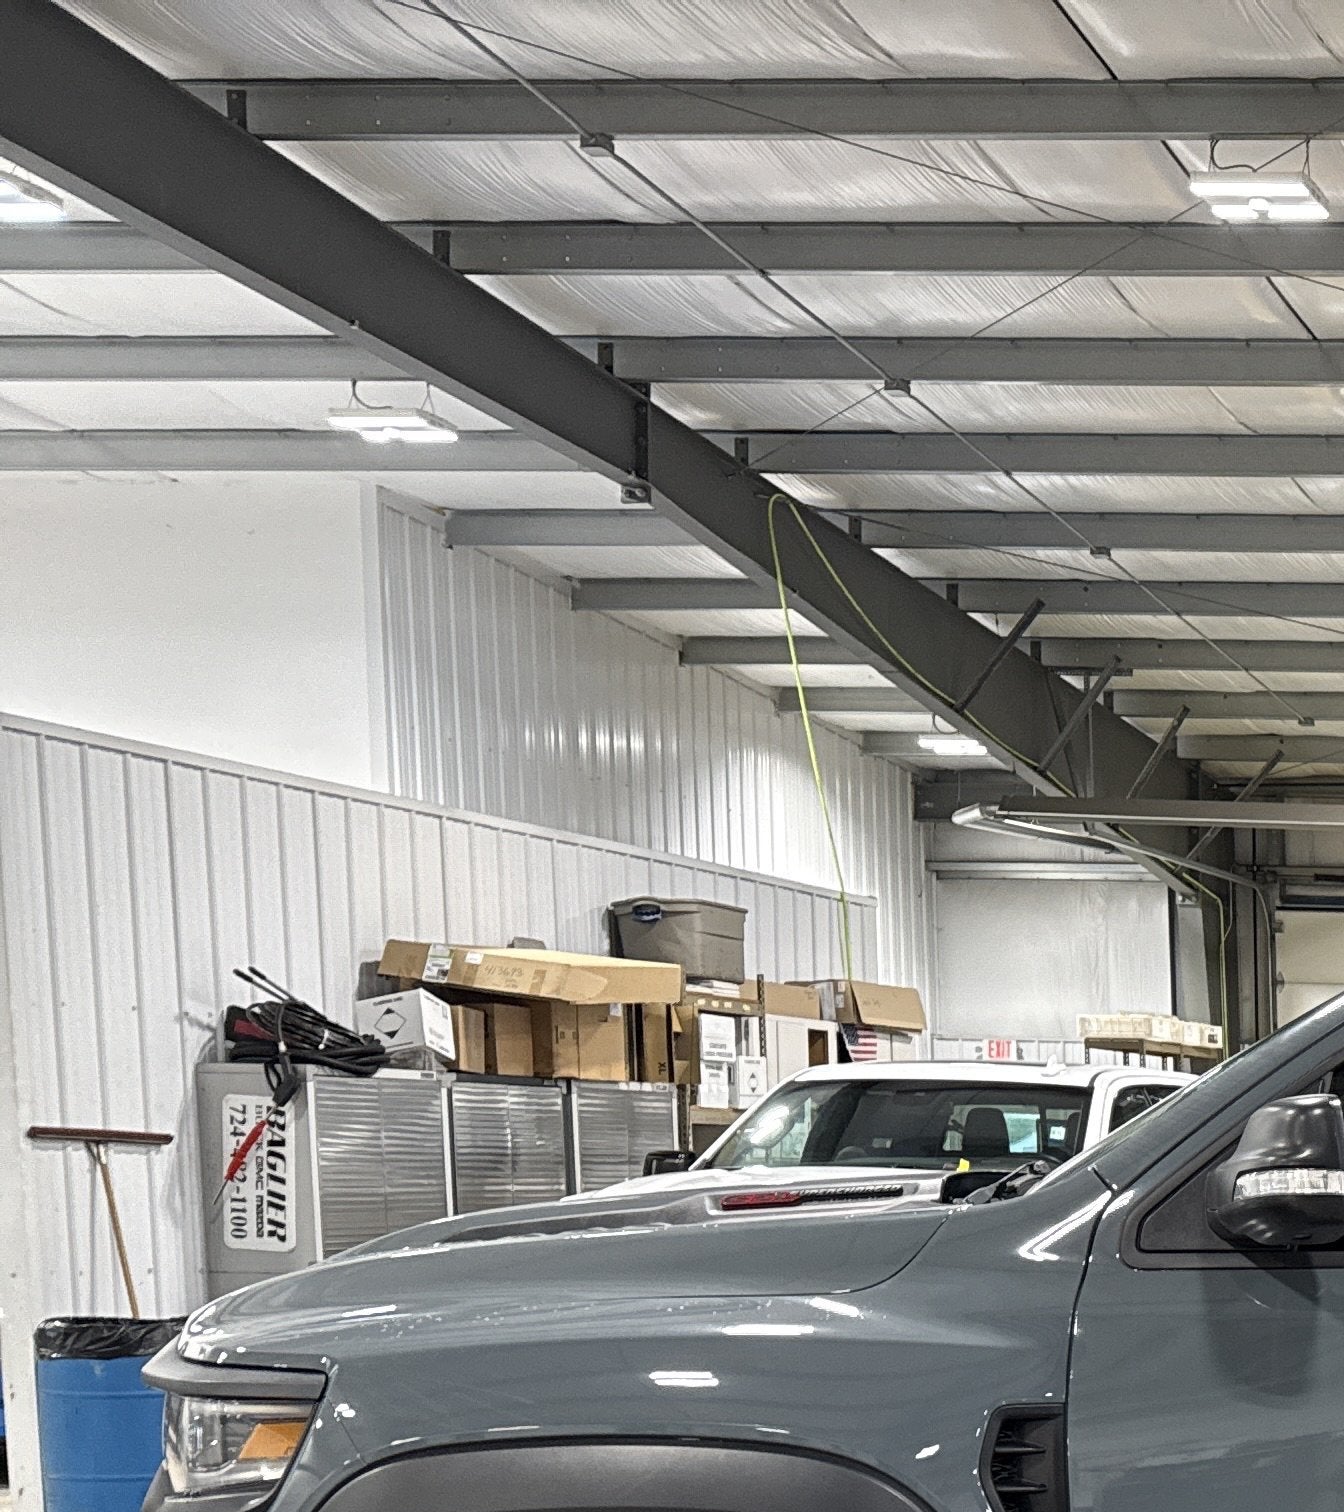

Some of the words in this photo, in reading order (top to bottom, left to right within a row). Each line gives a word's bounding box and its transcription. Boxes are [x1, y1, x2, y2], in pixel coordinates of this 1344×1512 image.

[987, 1039, 1012, 1059] EXIT
[657, 1061, 667, 1076] XL
[254, 1104, 264, 1152] BUK
[255, 1155, 265, 1191] GMC
[265, 1104, 287, 1243] BAGLIER
